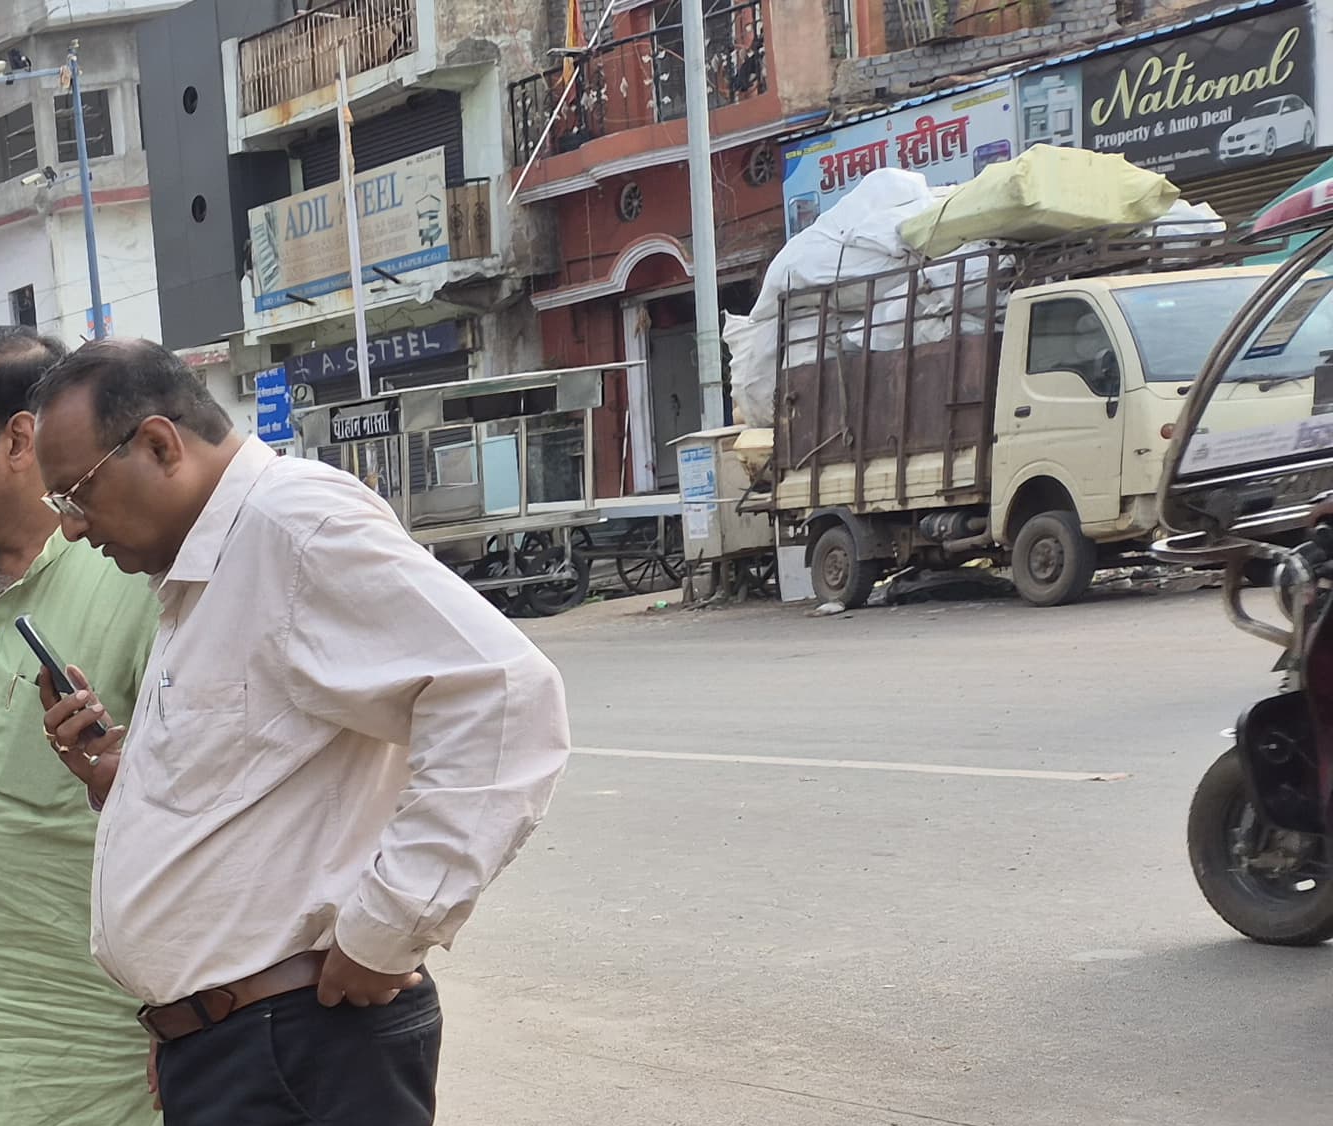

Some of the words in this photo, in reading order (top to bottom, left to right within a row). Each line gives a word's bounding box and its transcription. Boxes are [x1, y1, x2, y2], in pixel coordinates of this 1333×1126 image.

[1090, 27, 1300, 126] National
[895, 115, 970, 171] स्टील
[1094, 124, 1150, 149] Property
[1153, 121, 1165, 136] &
[1168, 114, 1198, 134] Auto
[1201, 105, 1232, 128] Deal
[284, 193, 333, 242] ADIL
[338, 171, 404, 225] TEEL
